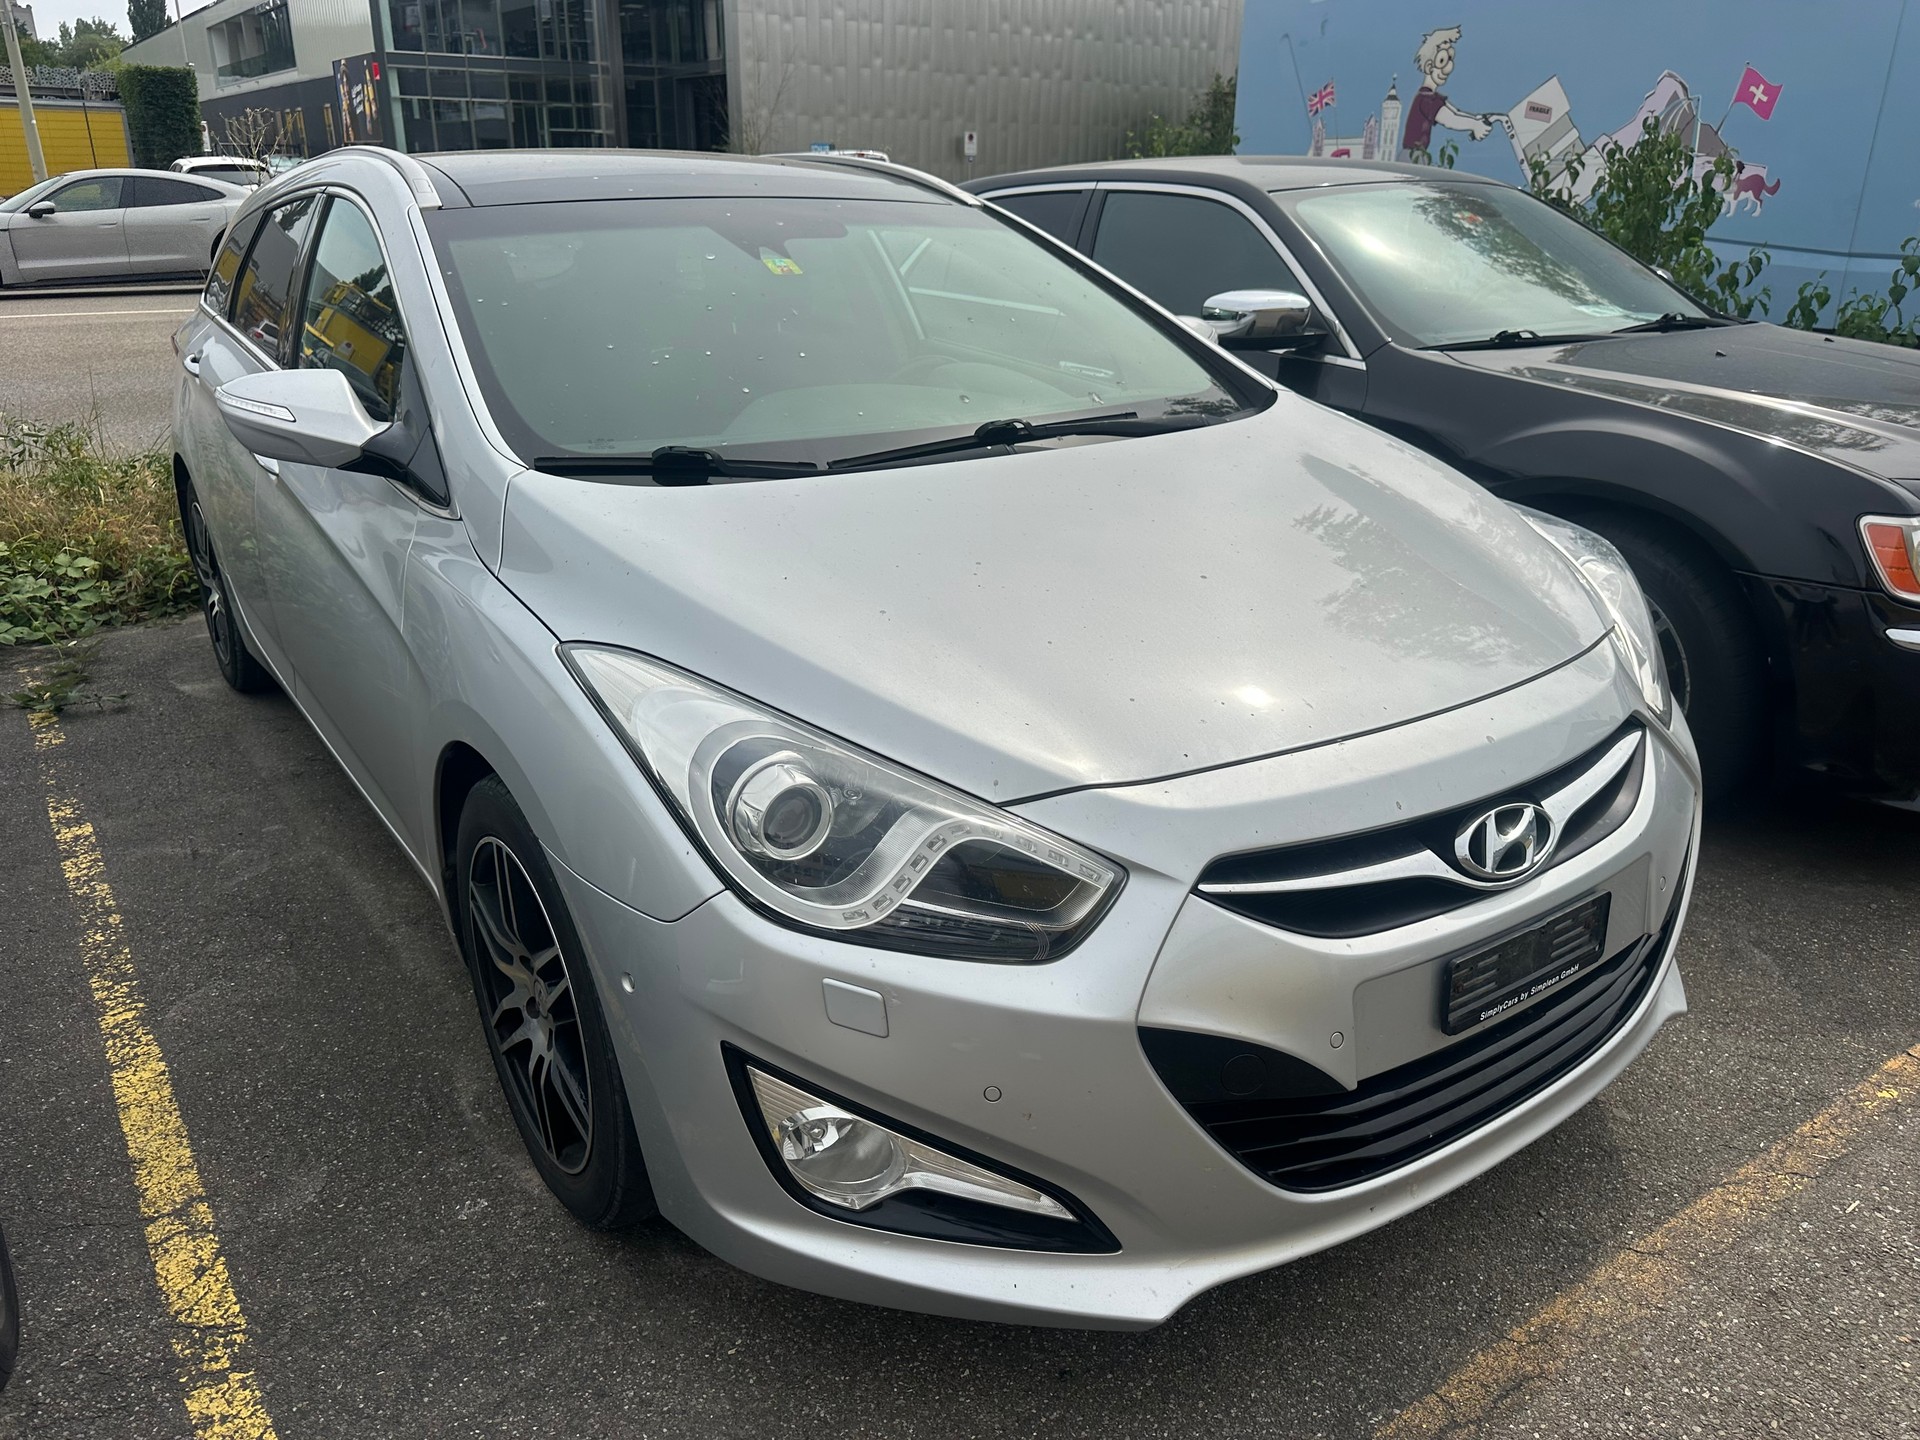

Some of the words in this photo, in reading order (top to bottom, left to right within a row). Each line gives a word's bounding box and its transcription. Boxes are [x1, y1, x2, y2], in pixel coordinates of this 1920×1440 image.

[1480, 996, 1518, 1020] SimplyCars
[1520, 991, 1529, 1001] by
[1530, 975, 1559, 995] Simplean
[1560, 963, 1580, 979] GmbH
